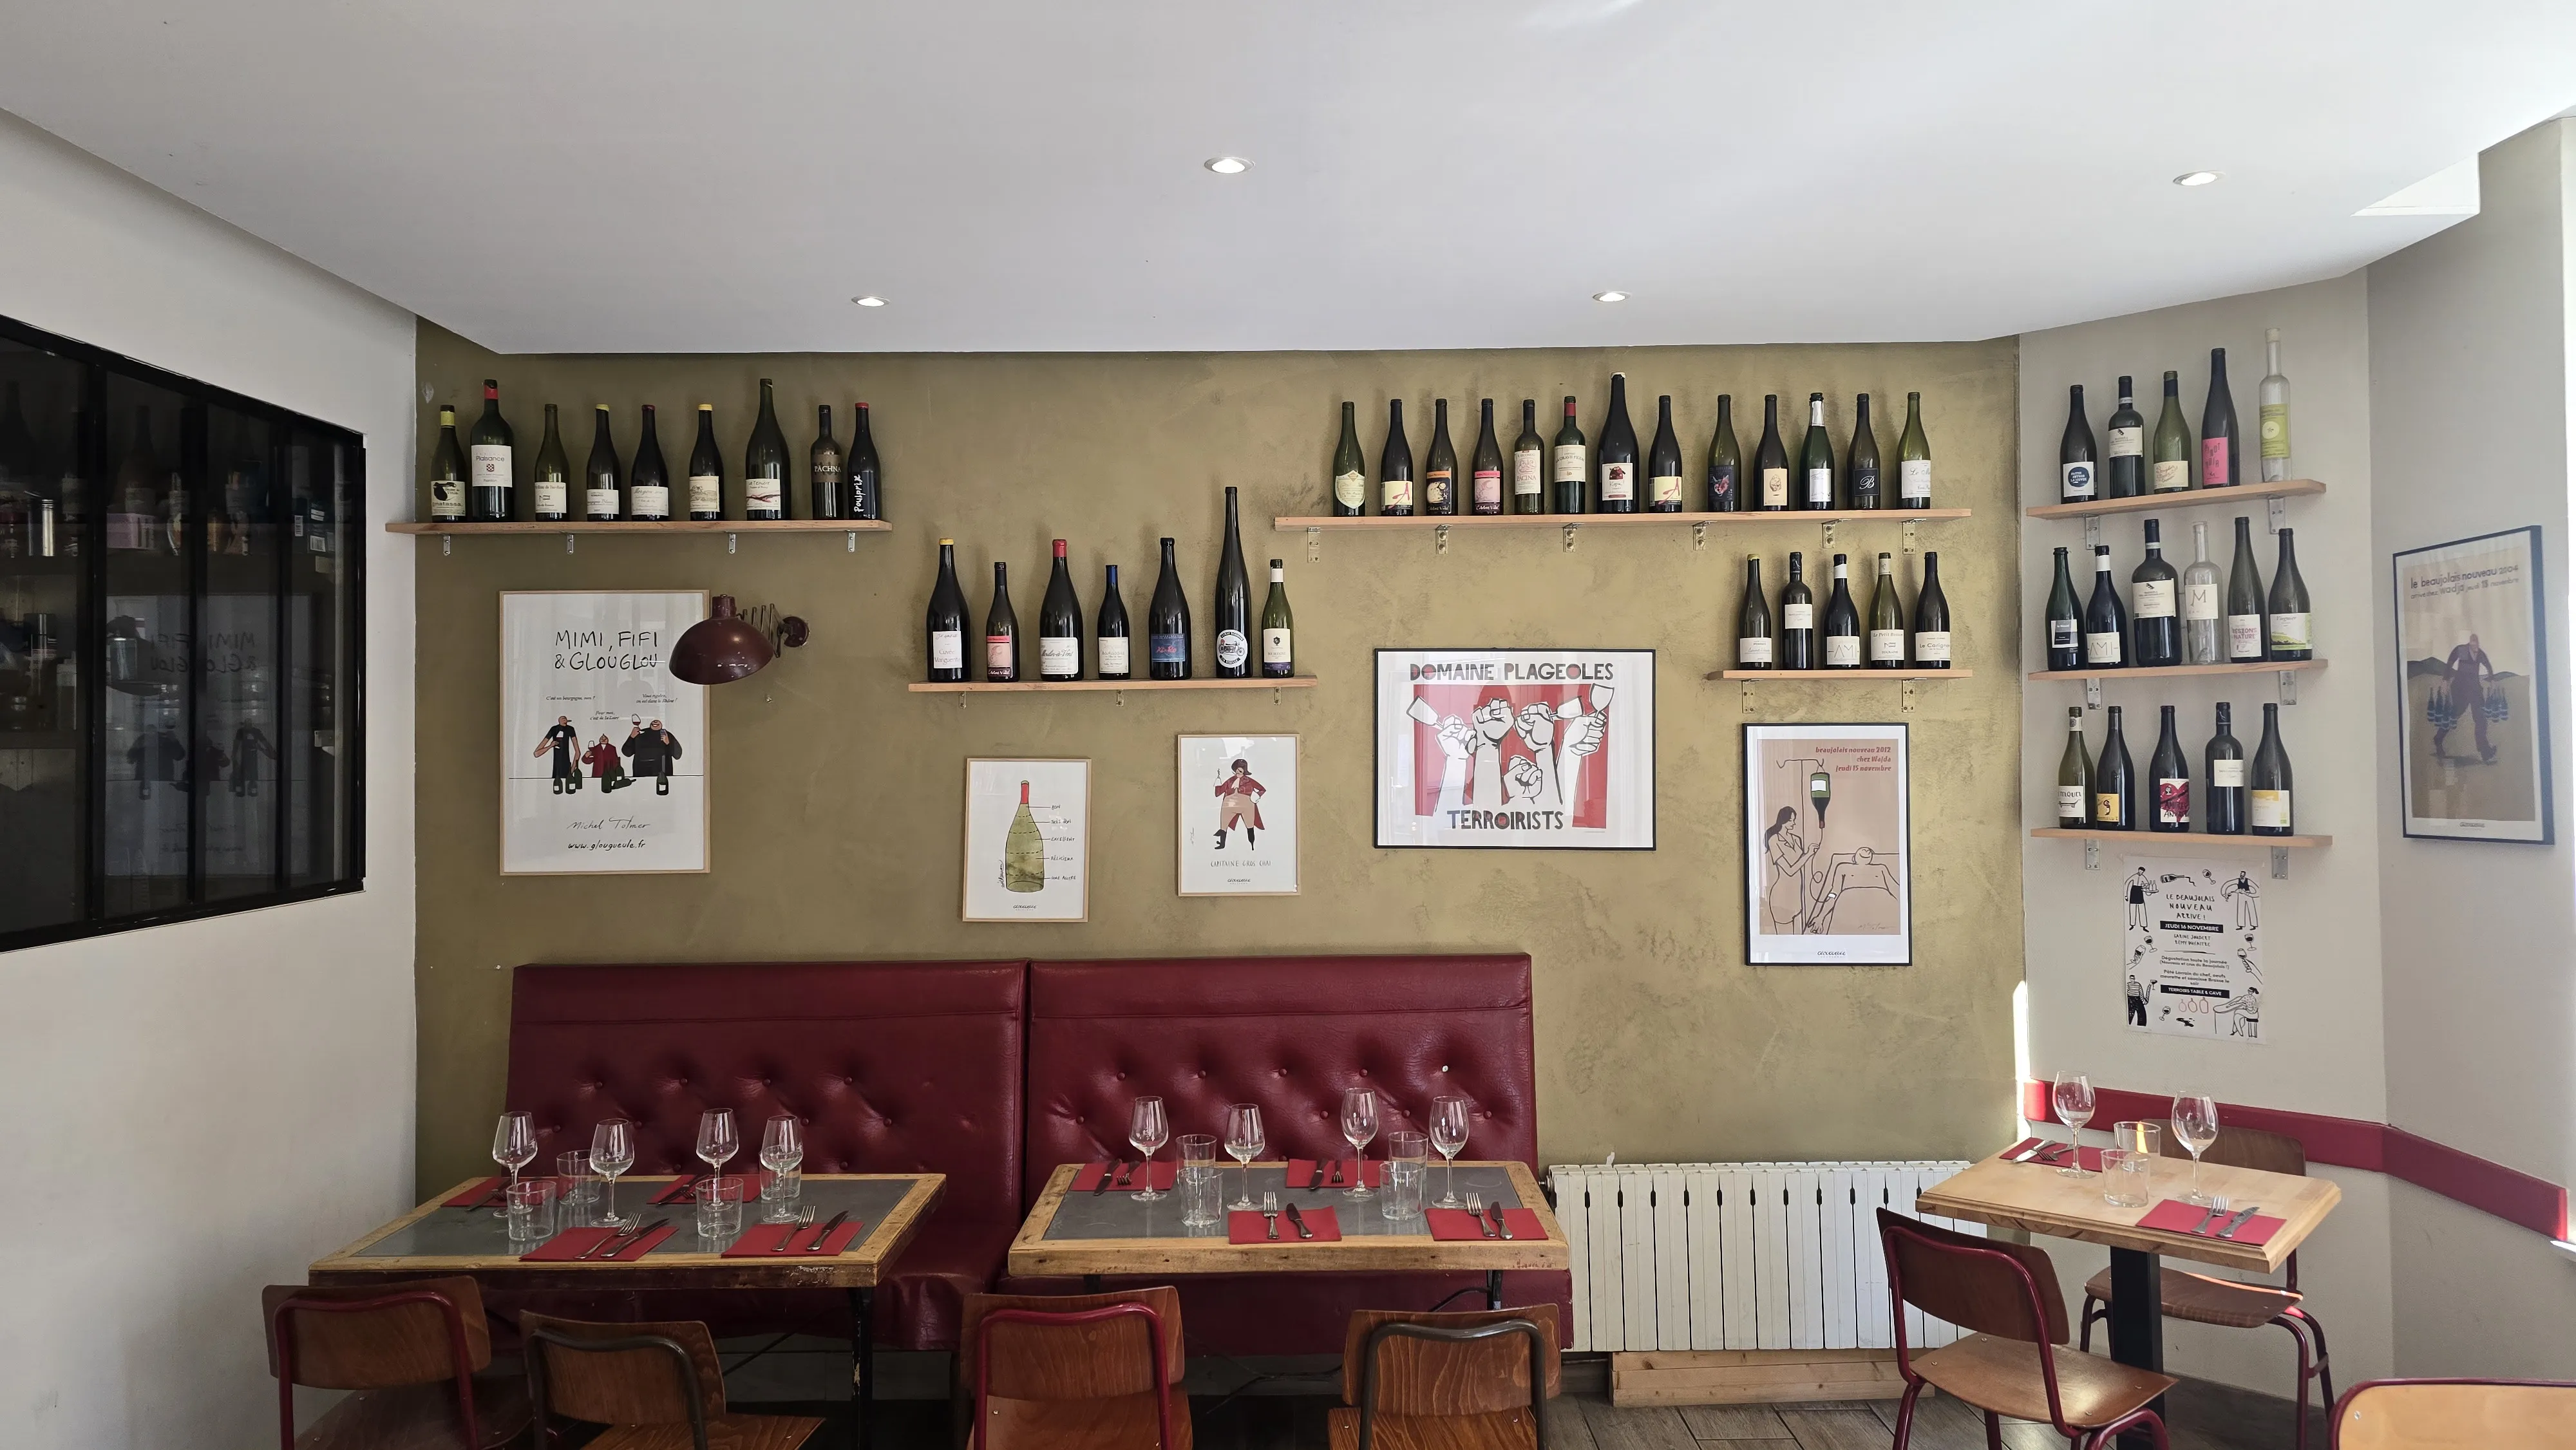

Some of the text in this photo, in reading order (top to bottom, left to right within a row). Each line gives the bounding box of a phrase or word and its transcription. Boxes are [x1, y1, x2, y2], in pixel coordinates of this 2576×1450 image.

[2410, 577, 2418, 589] le
[2420, 572, 2461, 587] beaujolais
[2461, 568, 2497, 580] nouveau
[2190, 589, 2206, 607] M
[618, 631, 657, 647] FIFI
[1833, 645, 1857, 658] AMI
[2089, 641, 2113, 655] AMI
[554, 652, 658, 671] & GLOUGLOU
[1410, 663, 1614, 681] DOMAINE PLAGEOLES
[1871, 755, 1891, 764] Wajda
[567, 815, 651, 829] Michel Tolmer
[1446, 809, 1564, 831] TERROIRISTS
[567, 839, 646, 851] www.glougueule.fr
[2176, 894, 2215, 902] BEAUJOLAIS
[2169, 903, 2213, 912] NOUVEAU
